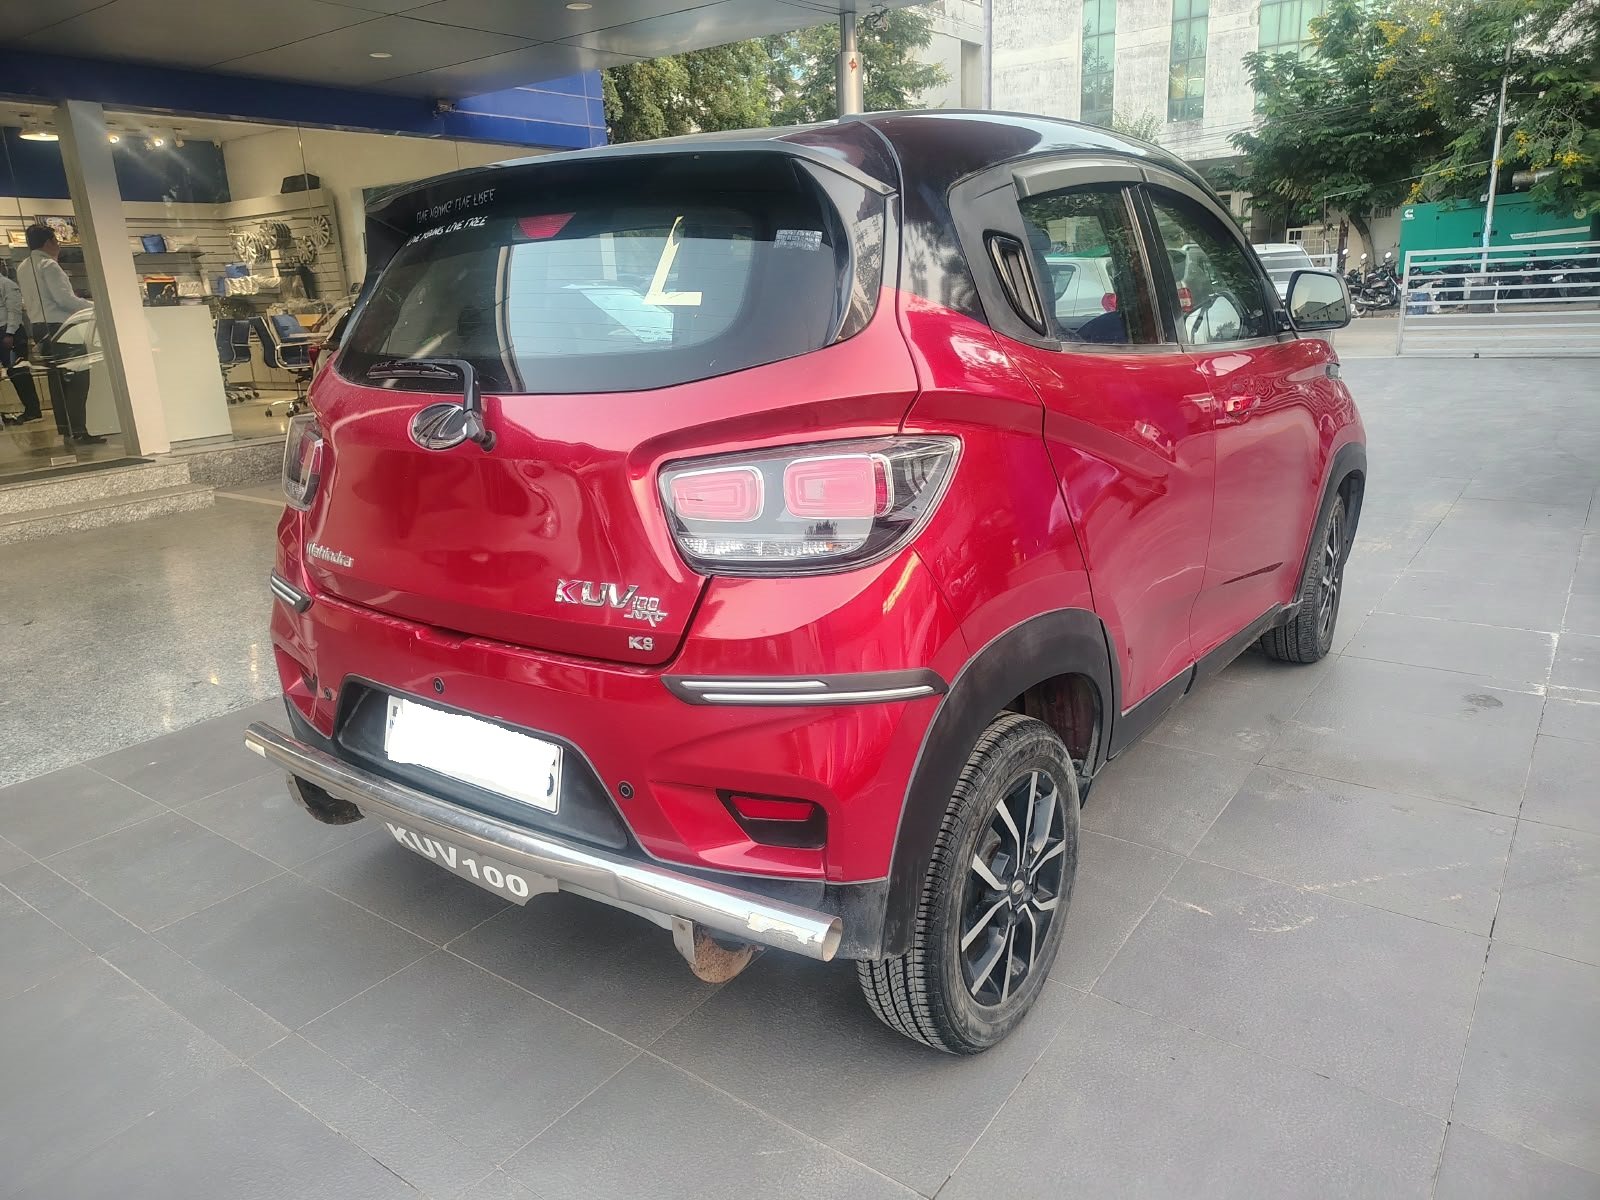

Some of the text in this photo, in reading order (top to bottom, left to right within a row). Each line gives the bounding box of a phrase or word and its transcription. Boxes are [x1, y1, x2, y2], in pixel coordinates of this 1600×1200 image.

[305, 542, 354, 568] Mahindra
[628, 636, 654, 651] K8
[385, 821, 529, 897] KUV100
